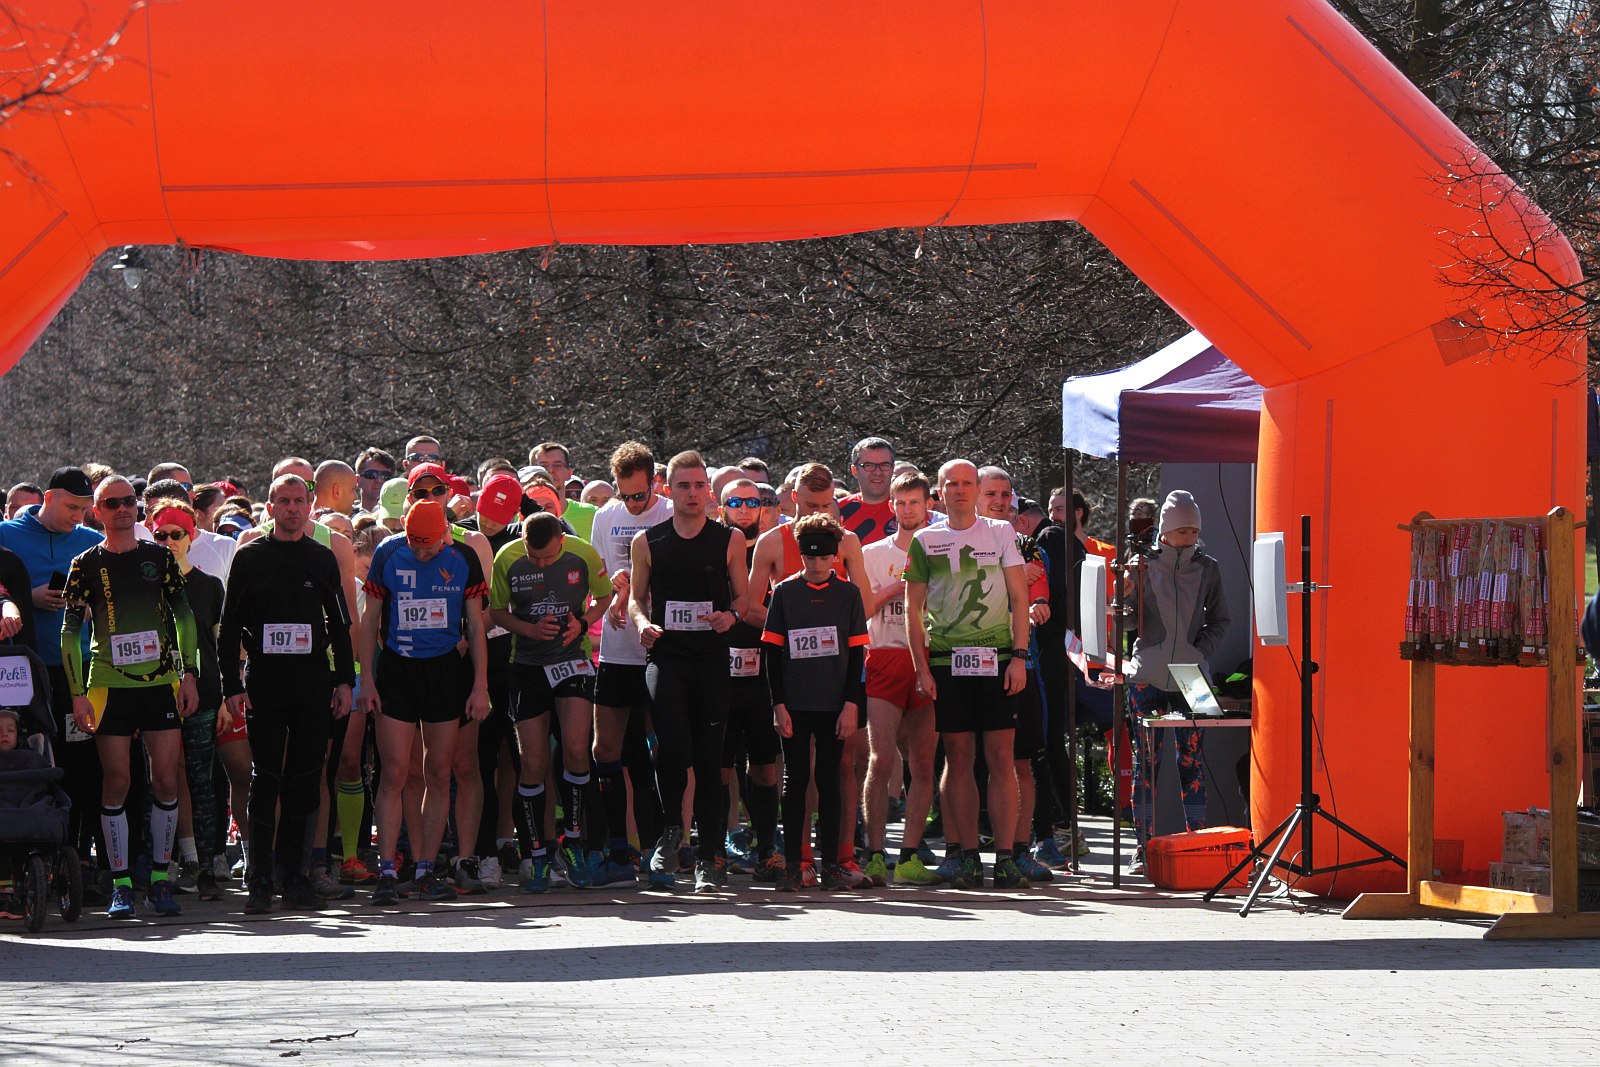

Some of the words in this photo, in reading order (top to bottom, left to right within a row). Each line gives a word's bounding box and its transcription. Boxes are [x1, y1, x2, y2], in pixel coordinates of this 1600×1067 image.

[409, 533, 430, 544] CCC
[520, 573, 544, 581] KGHM
[403, 607, 428, 622] 192
[529, 604, 569, 616] ZGRun
[889, 601, 906, 616] 16
[670, 609, 693, 624] 115
[268, 631, 292, 646] 197
[793, 635, 819, 651] 128
[116, 641, 142, 657] 195
[954, 654, 981, 669] 085
[550, 661, 576, 681] 051
[70, 721, 79, 735] 2
